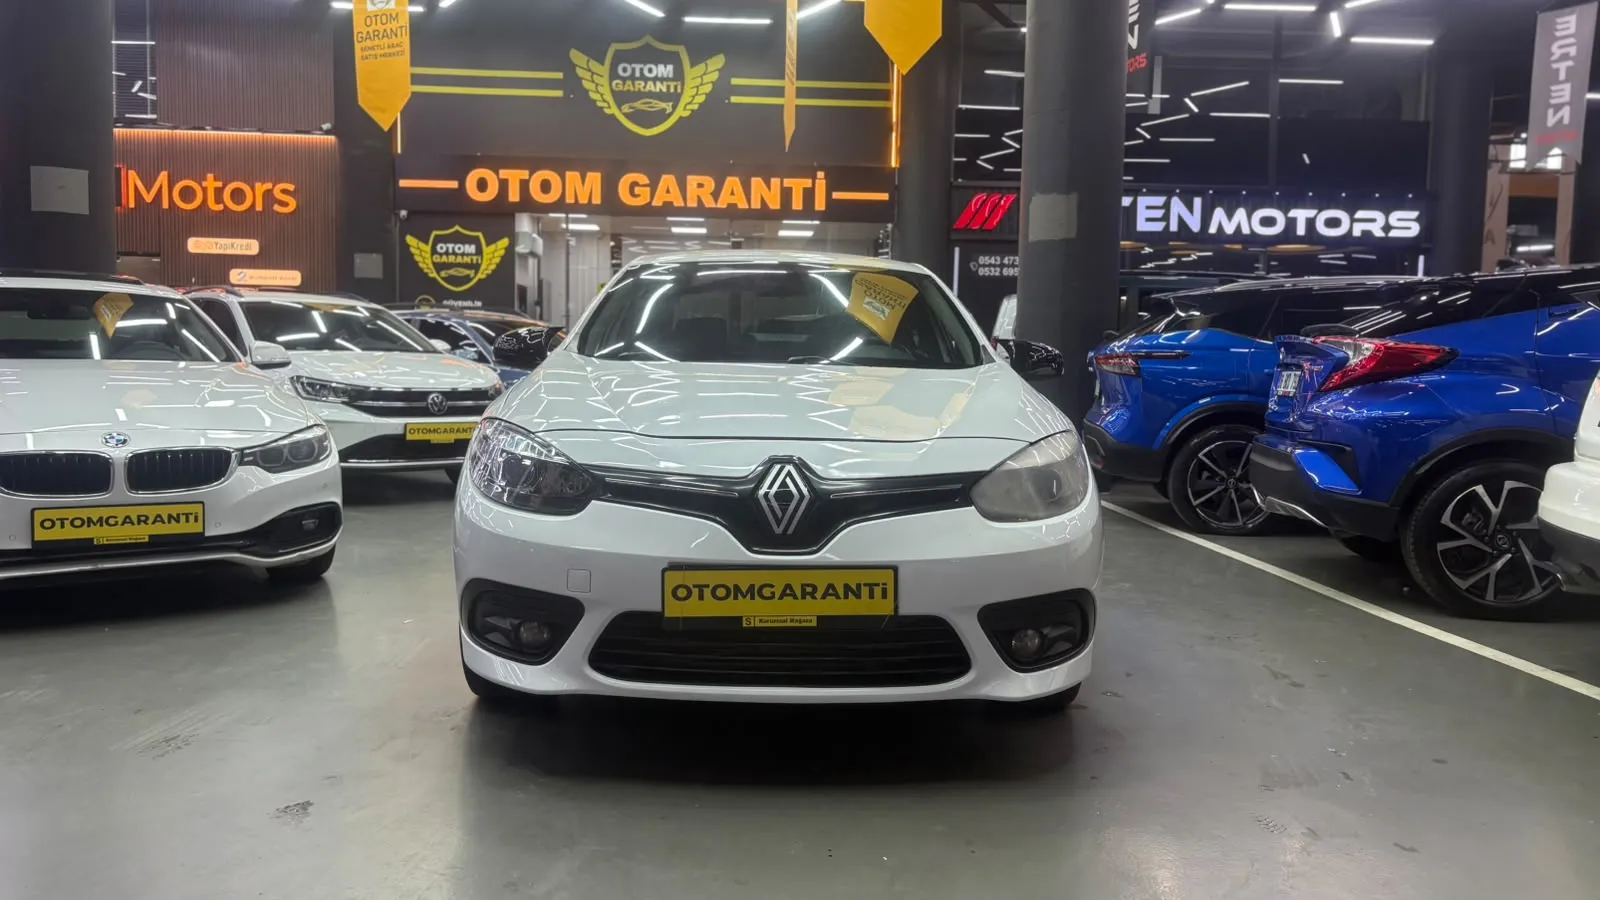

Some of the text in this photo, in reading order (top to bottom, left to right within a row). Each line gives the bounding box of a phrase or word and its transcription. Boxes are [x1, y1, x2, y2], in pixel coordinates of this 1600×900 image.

[364, 12, 399, 28] OTOM
[617, 63, 674, 78] OTOM
[127, 169, 298, 214] Motors
[465, 167, 602, 205] OTOM
[1207, 206, 1422, 238] MOTORS
[436, 243, 477, 254] OTOM
[978, 255, 1001, 265] 0543
[978, 266, 1001, 276] 0532
